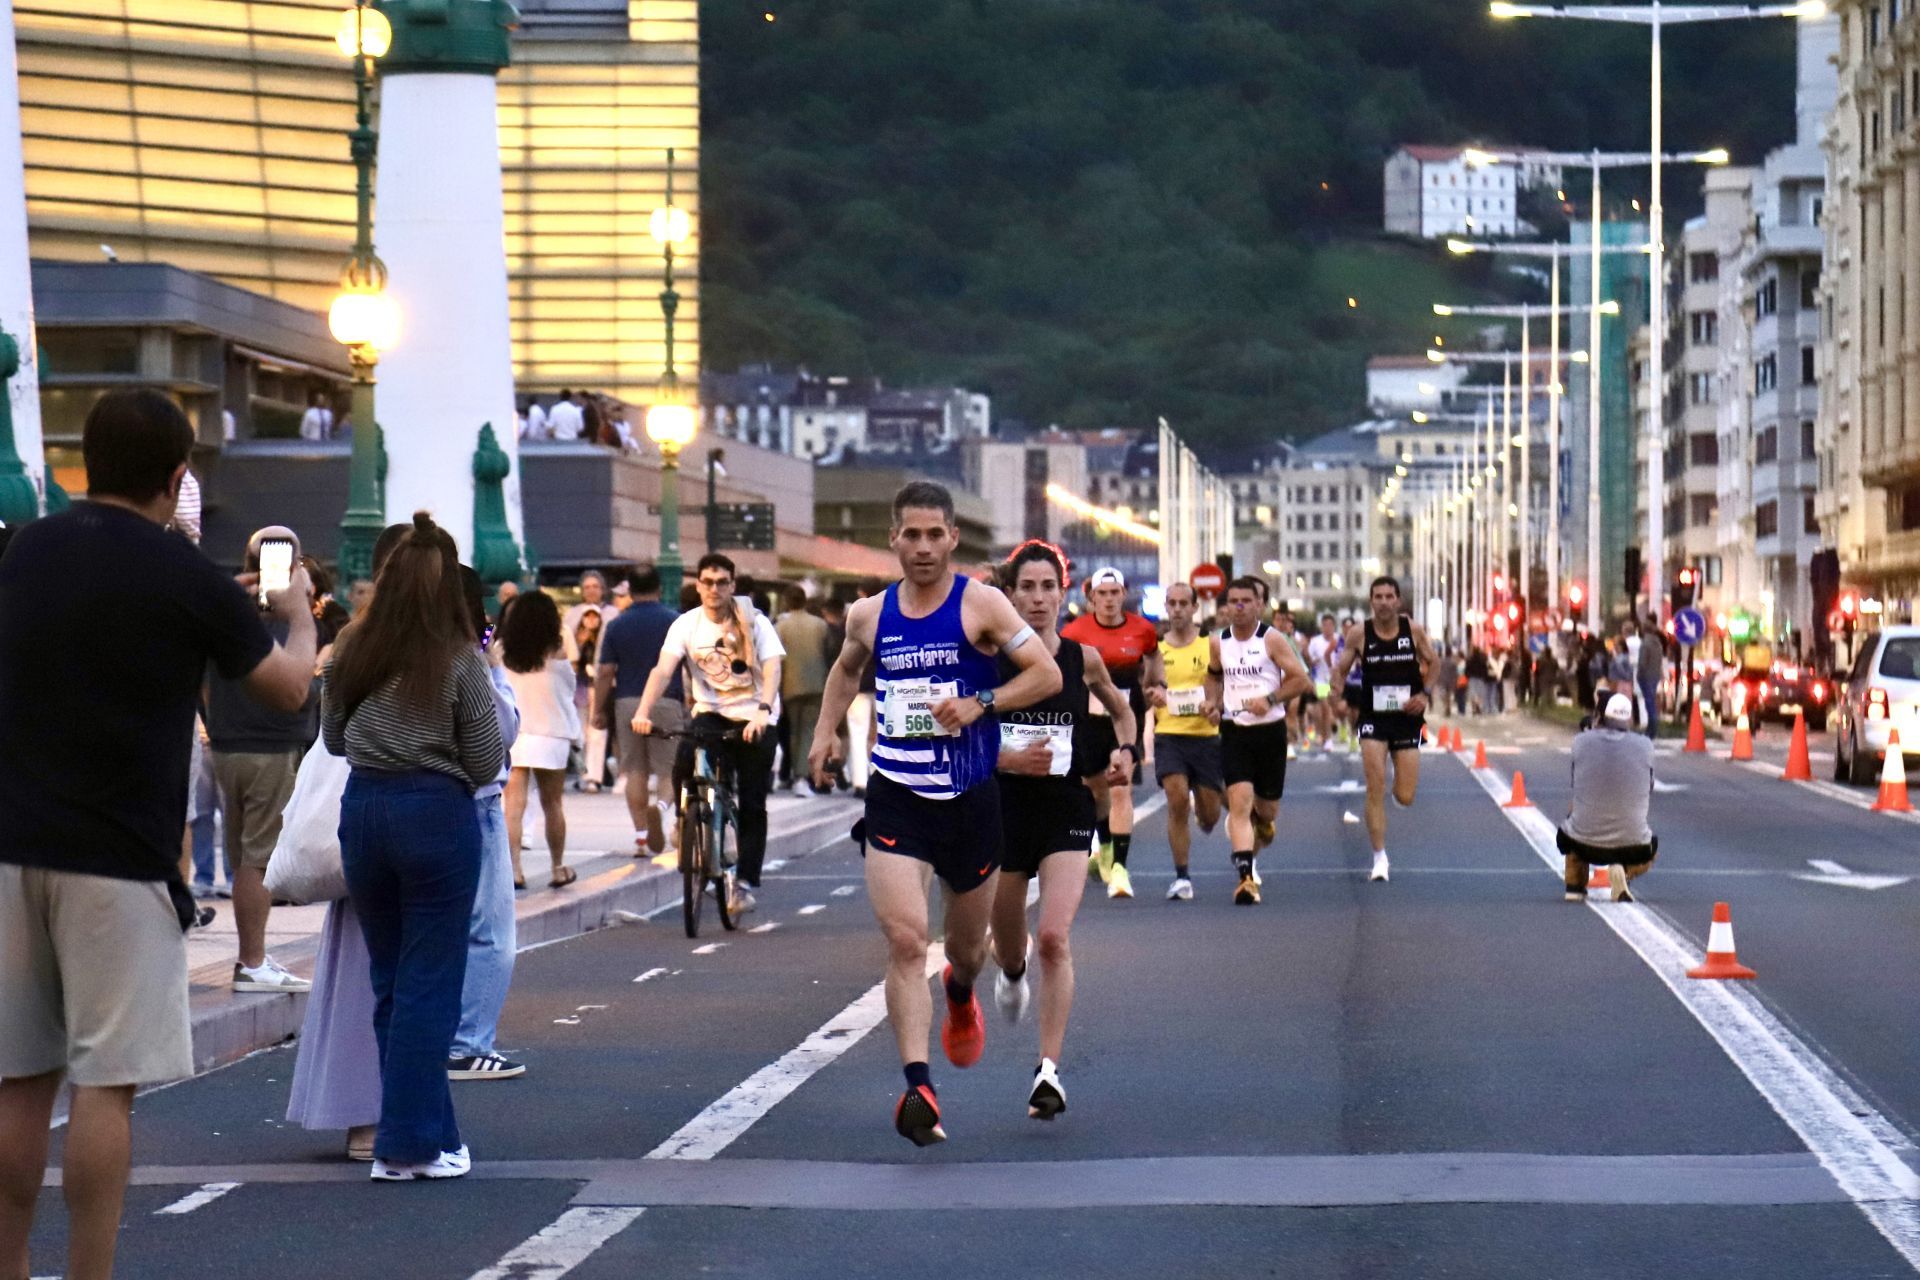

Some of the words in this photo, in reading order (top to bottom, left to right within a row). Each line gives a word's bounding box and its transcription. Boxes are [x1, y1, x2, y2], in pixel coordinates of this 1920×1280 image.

[891, 645, 918, 654] DEPORTIVO
[905, 714, 933, 732] 566
[1011, 711, 1073, 725] OYSHO
